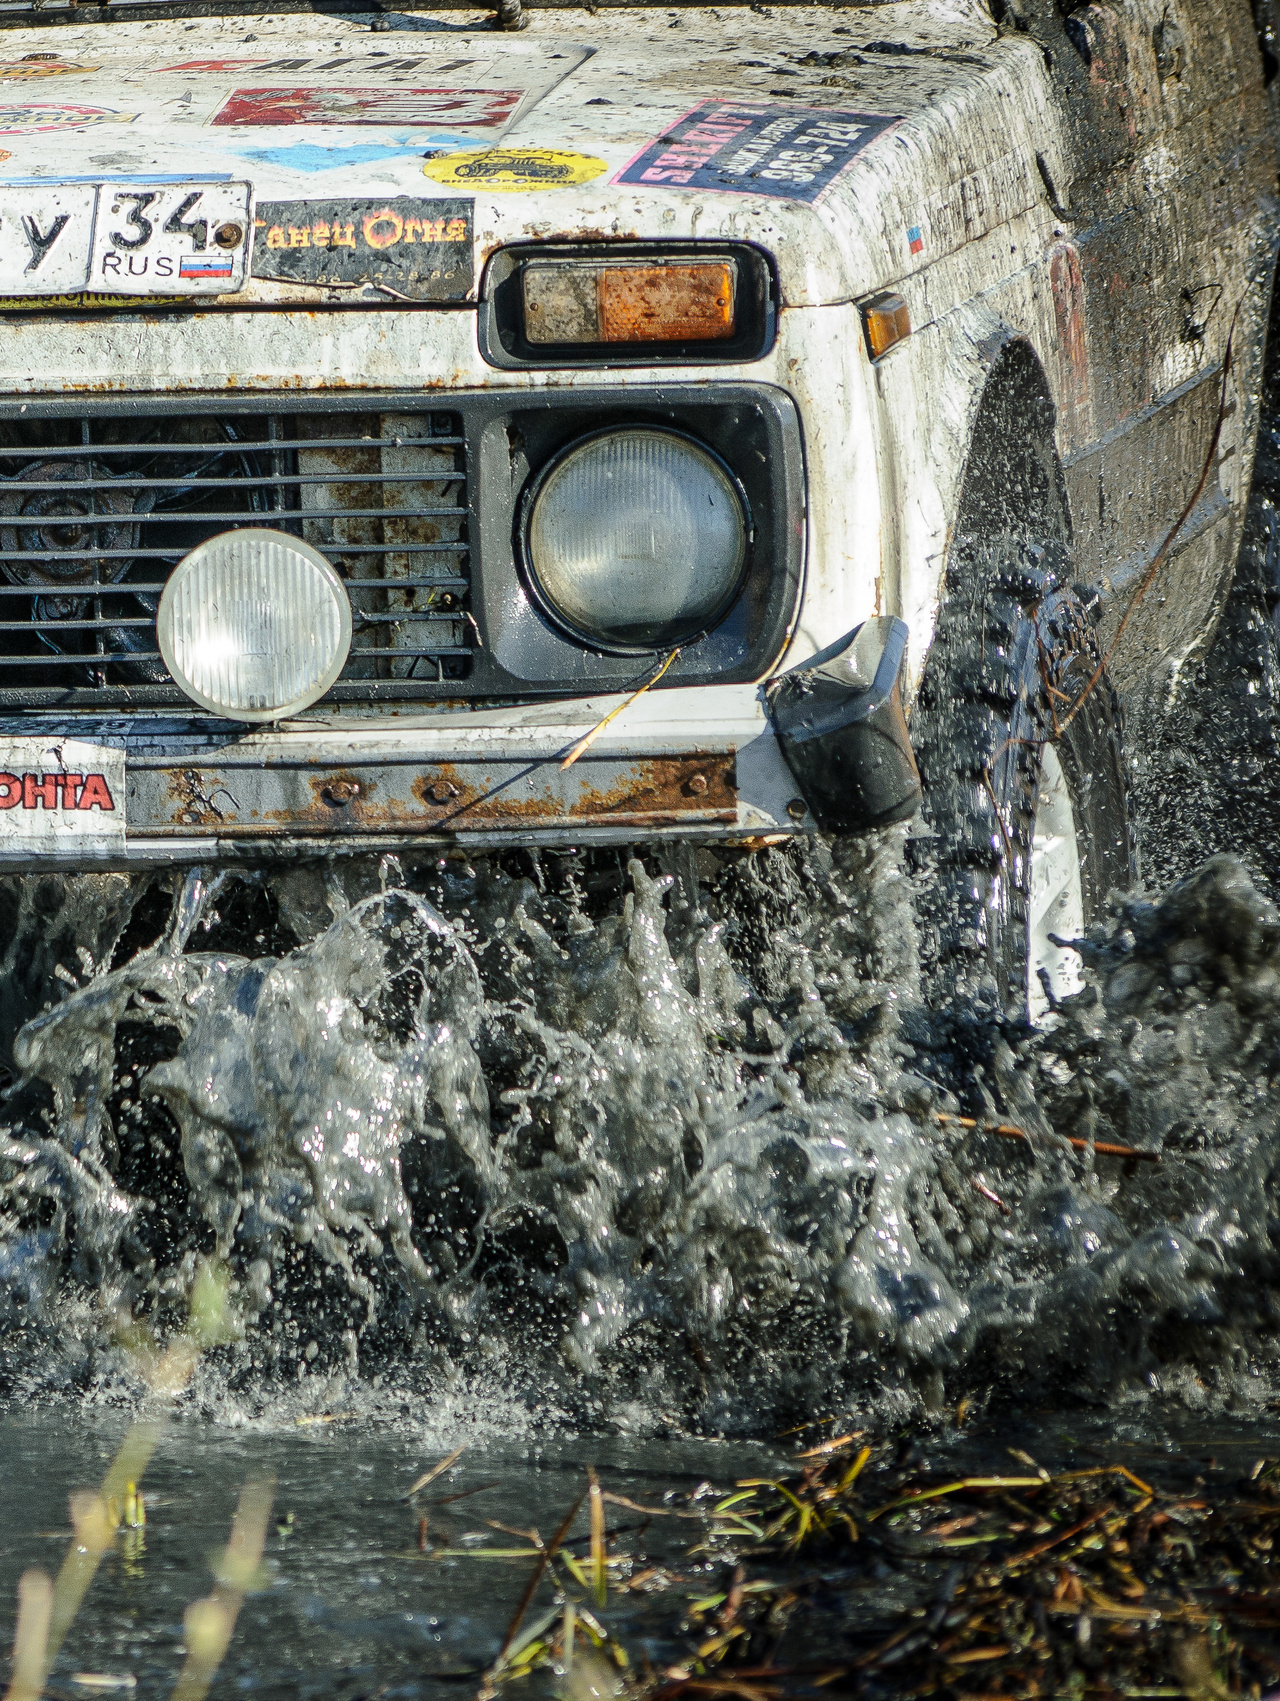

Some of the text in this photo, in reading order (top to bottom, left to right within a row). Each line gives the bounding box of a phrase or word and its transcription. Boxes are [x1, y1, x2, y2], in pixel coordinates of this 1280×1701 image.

[638, 103, 767, 184] SHERIFF
[109, 191, 209, 253] 34
[255, 218, 357, 250] анец
[102, 256, 174, 277] RUS
